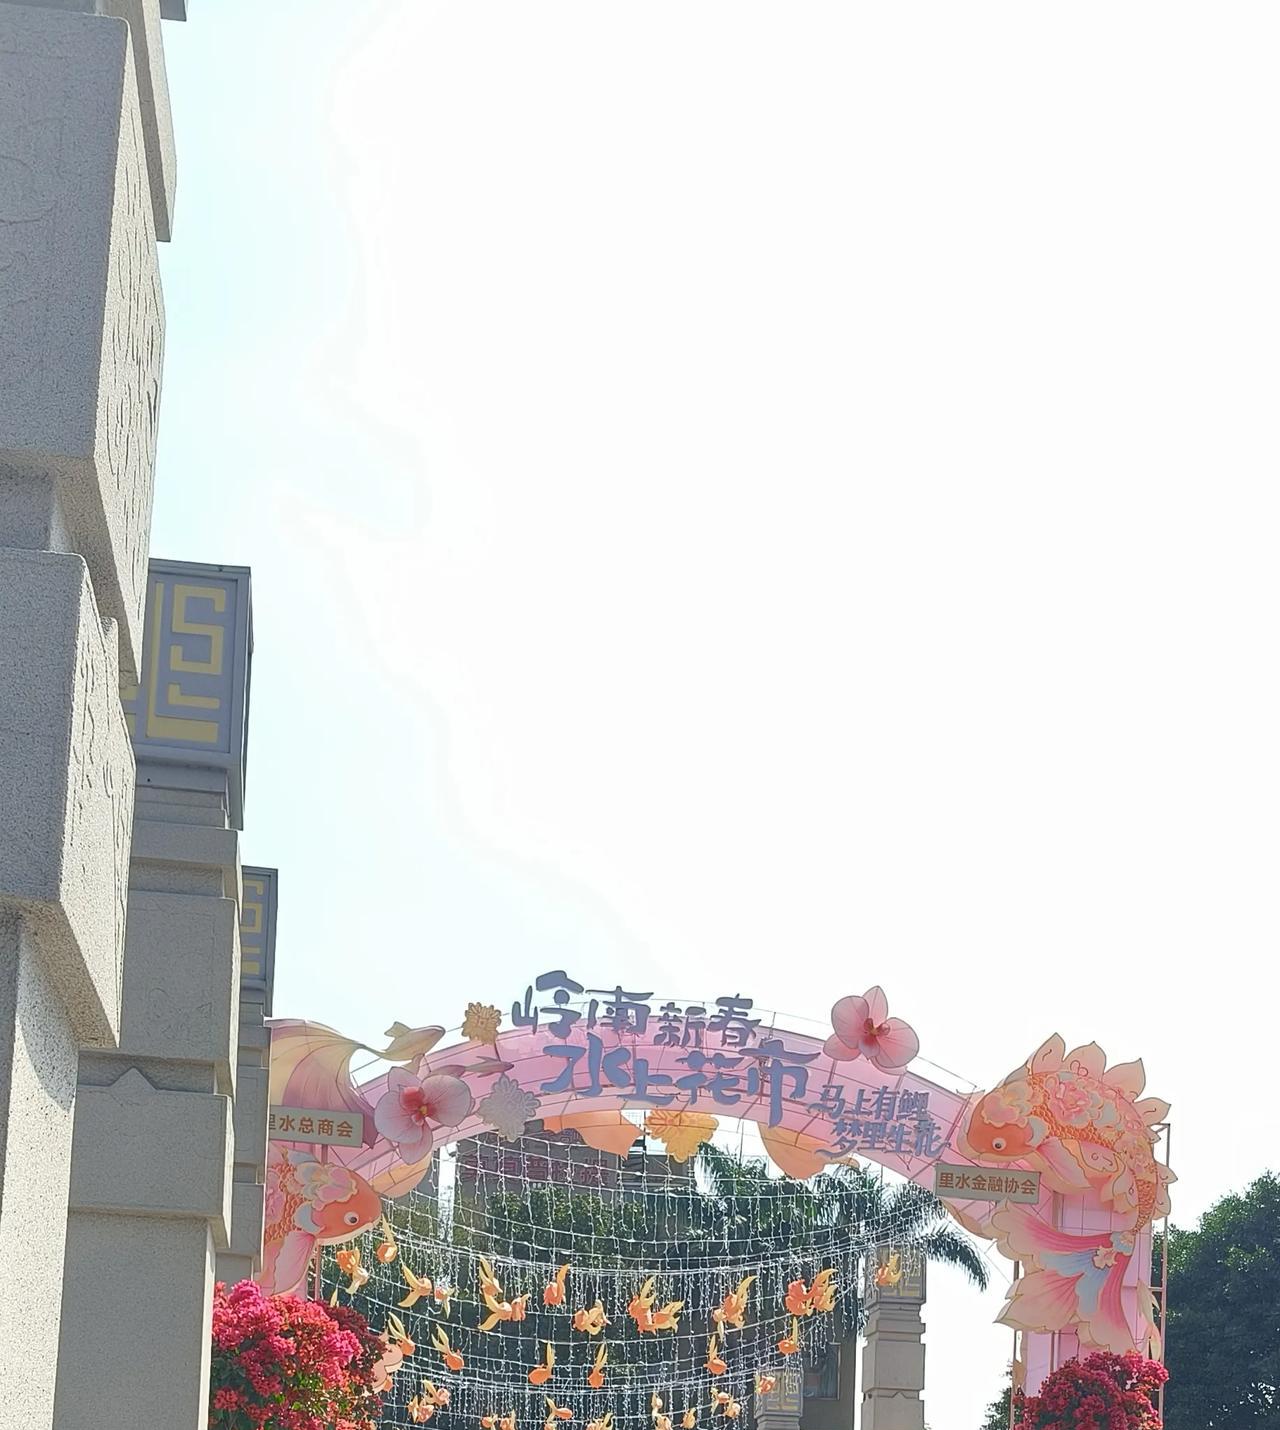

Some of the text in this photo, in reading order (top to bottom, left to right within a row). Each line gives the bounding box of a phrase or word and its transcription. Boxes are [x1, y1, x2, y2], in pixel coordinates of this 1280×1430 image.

[511, 970, 762, 1047] 岭南新春
[540, 1031, 822, 1129] 水上花市
[806, 1083, 934, 1122] 马上有鲤
[815, 1116, 952, 1160] 梦里生花
[938, 1171, 1037, 1196] 里水金融协会
